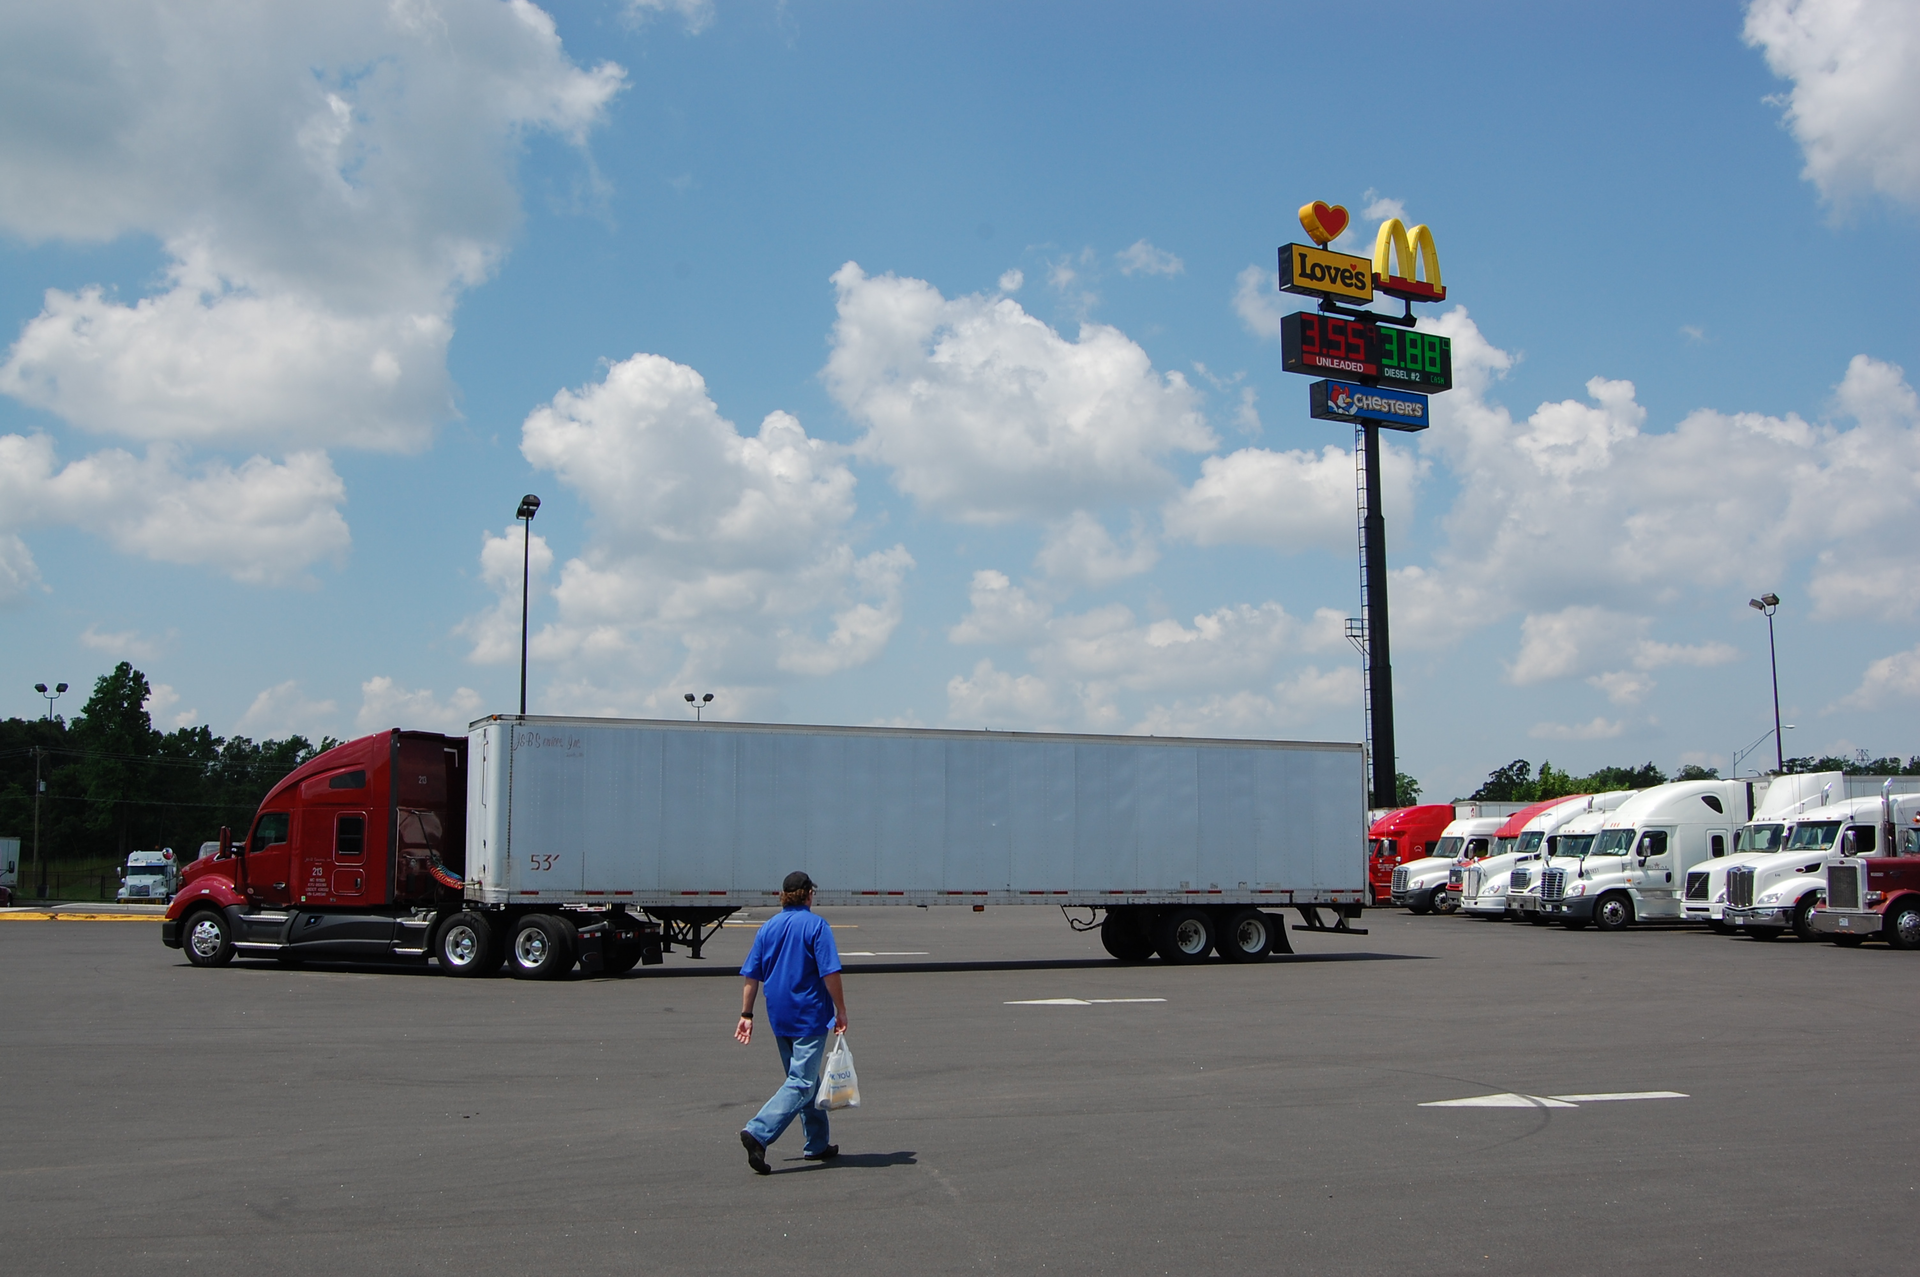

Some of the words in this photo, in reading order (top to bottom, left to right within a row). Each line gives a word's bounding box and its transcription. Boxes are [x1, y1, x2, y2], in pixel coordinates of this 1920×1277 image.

[1316, 356, 1364, 373] UNLEADED
[1384, 367, 1409, 380] DIESEL
[1410, 371, 1421, 382] #2
[1430, 375, 1445, 385] CASH
[312, 867, 323, 876] 213
[837, 1070, 851, 1080] YOU
